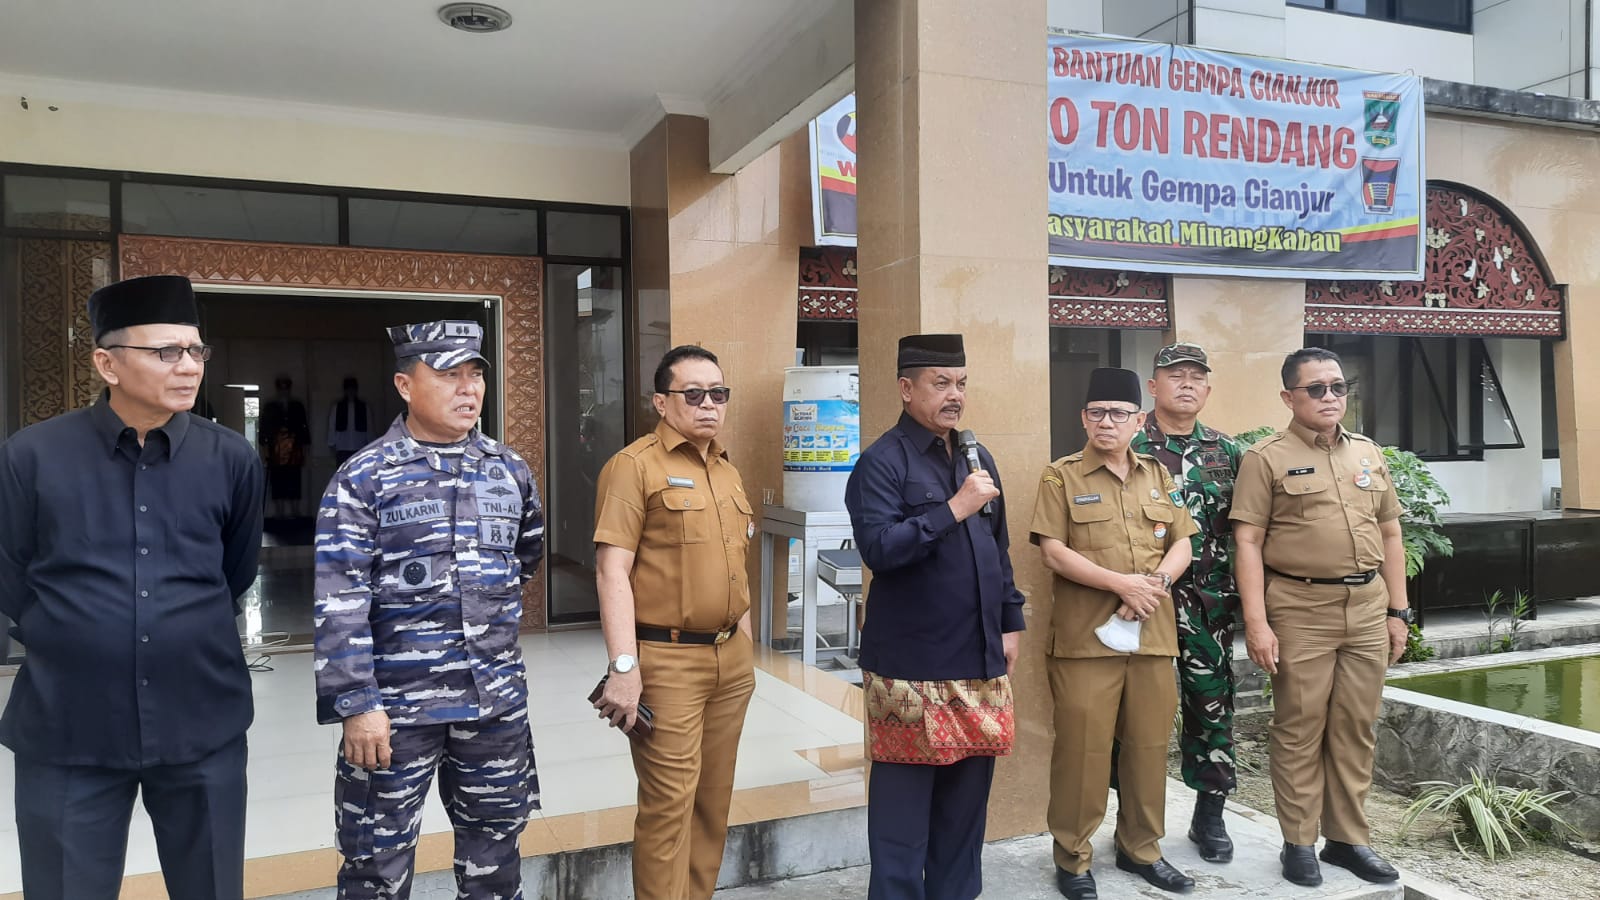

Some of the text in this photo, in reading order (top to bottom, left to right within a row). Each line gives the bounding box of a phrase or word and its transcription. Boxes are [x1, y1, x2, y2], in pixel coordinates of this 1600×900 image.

[1052, 47, 1341, 109] BANTUAN GEMPA CIANJUR
[1090, 101, 1169, 154] TON
[1183, 110, 1357, 169] RENDANG
[1048, 162, 1335, 219] Untuk Gempa Cianjur
[1179, 221, 1342, 252] MinangKabau
[385, 503, 441, 523] ZULKARNI
[482, 502, 519, 515] TNI-AL
